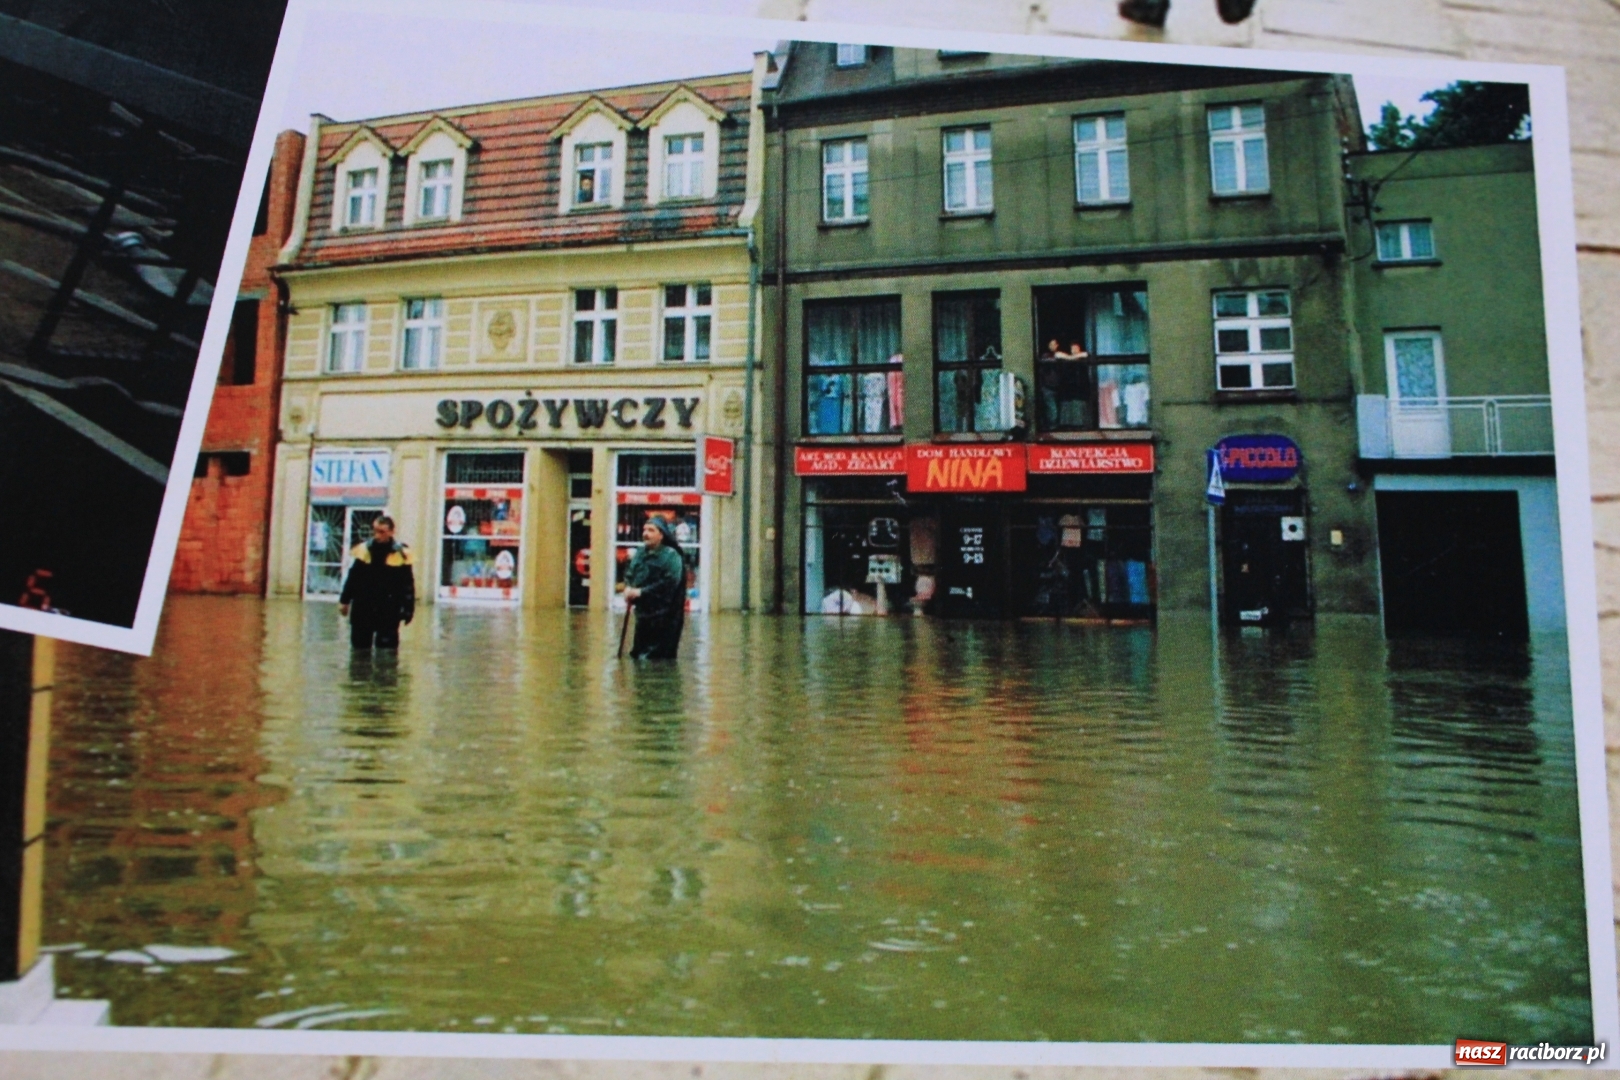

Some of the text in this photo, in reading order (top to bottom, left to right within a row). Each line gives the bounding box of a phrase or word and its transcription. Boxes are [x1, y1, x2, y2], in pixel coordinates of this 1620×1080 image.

[436, 391, 700, 430] SPOŻYWCZY
[917, 448, 1013, 458] DOM HANDLOWY
[1050, 447, 1128, 459] KONFEKCJA
[314, 459, 386, 483] STEFAN
[925, 456, 1003, 488] NINA
[1039, 458, 1143, 469] DZIEWIARSTWO
